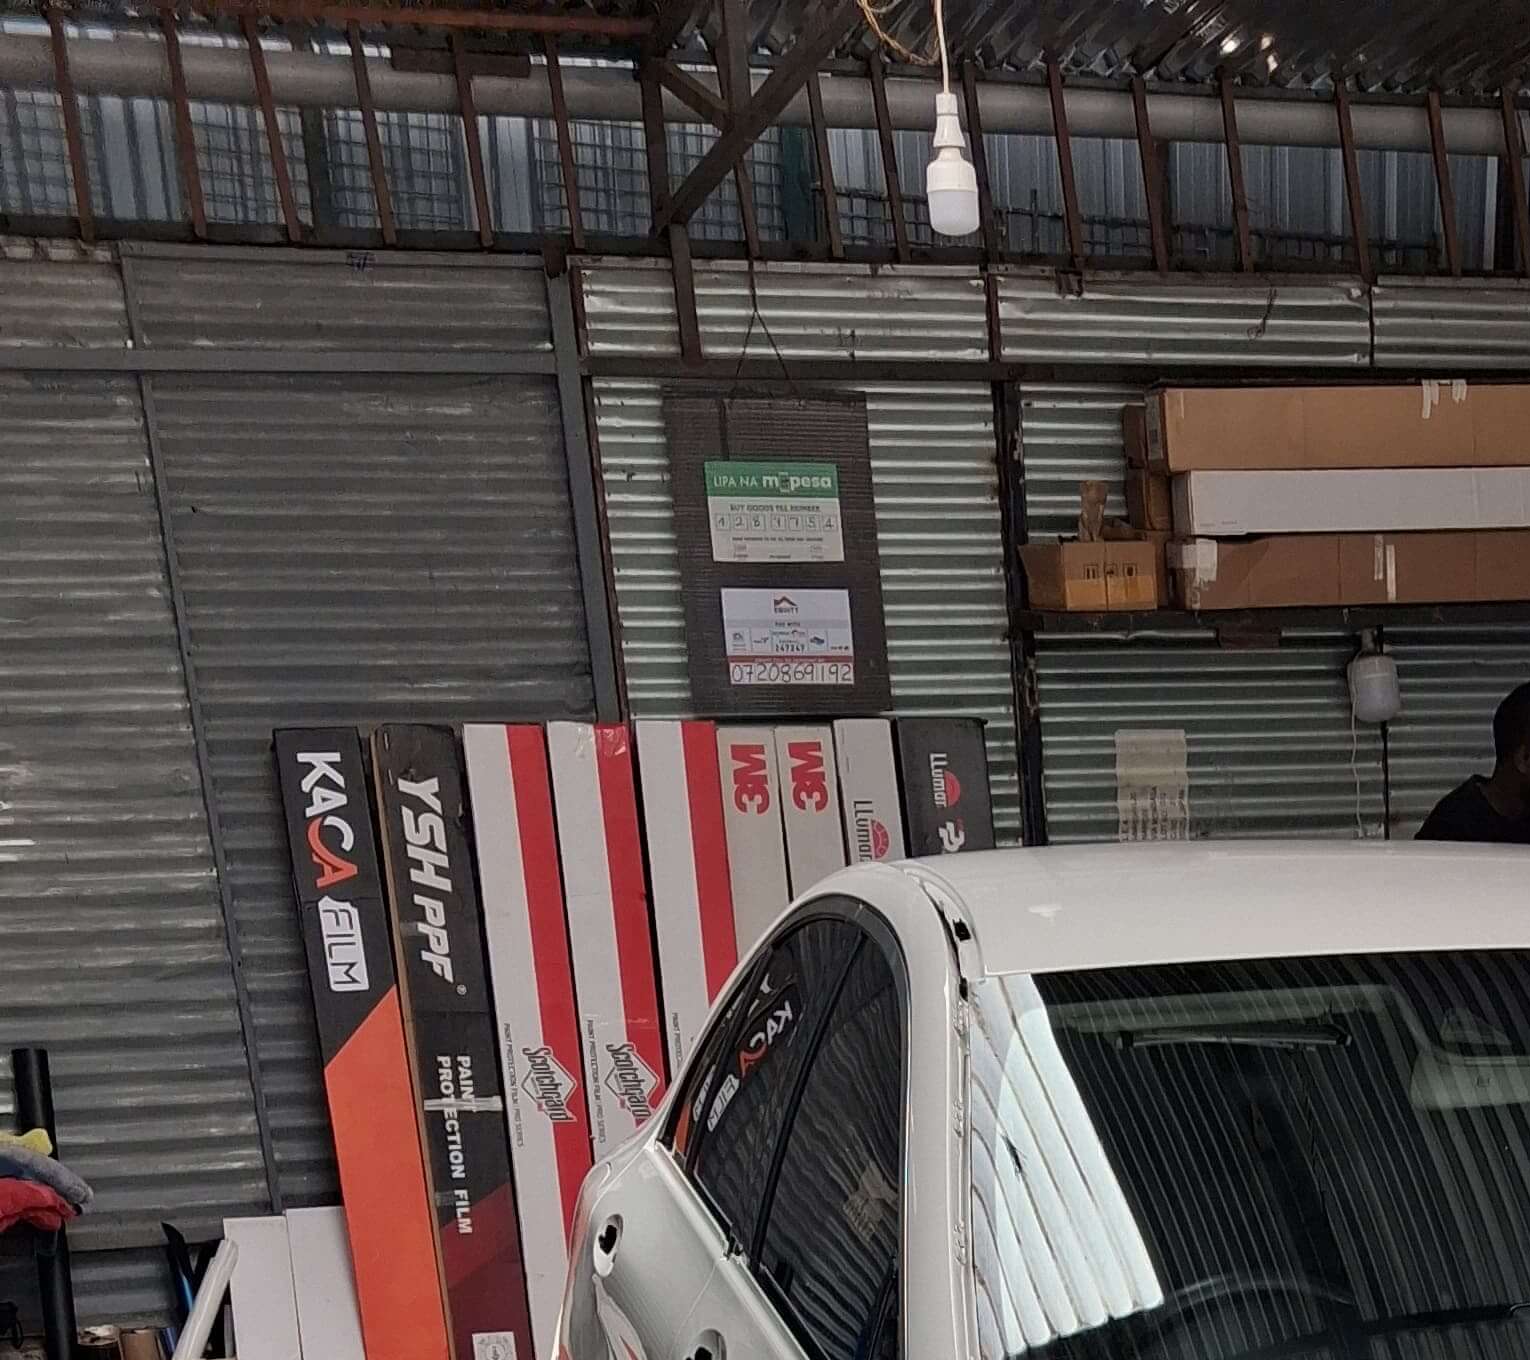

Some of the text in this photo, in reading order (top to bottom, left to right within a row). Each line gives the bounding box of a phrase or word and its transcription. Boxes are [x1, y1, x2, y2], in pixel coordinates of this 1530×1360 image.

[713, 475, 737, 488] LIPA
[740, 475, 758, 488] NA
[731, 744, 770, 815] 3M
[788, 741, 829, 813] 3M
[296, 752, 359, 889] KACA
[396, 776, 454, 984] YSH PPF
[321, 907, 362, 985] FILM
[522, 1047, 575, 1121] Scotchgard
[437, 1055, 473, 1234] PROECTION FILM
